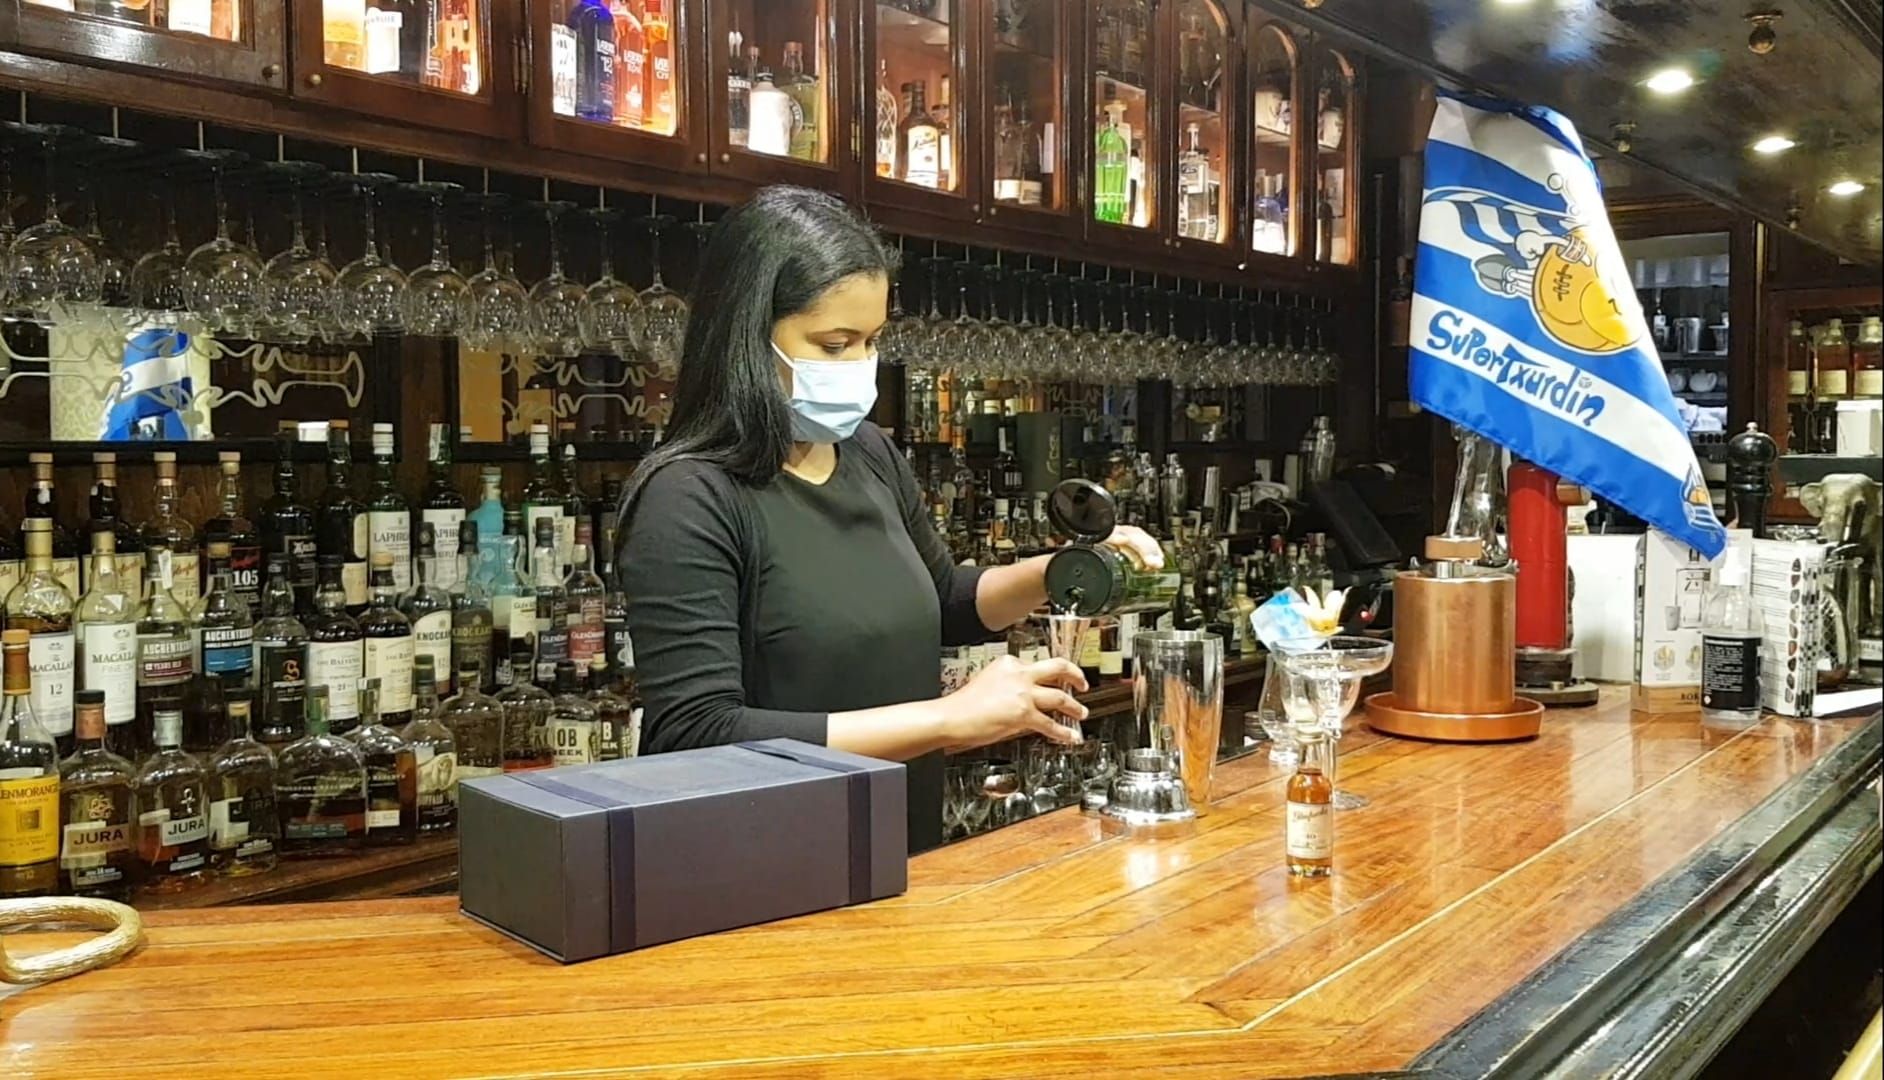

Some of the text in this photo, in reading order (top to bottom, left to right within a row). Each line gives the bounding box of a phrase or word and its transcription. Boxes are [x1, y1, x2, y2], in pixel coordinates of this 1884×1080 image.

[233, 570, 259, 586] 105
[50, 685, 63, 695] 12
[557, 728, 577, 747] OB
[168, 819, 206, 836] JURA
[73, 828, 124, 845] JURA
